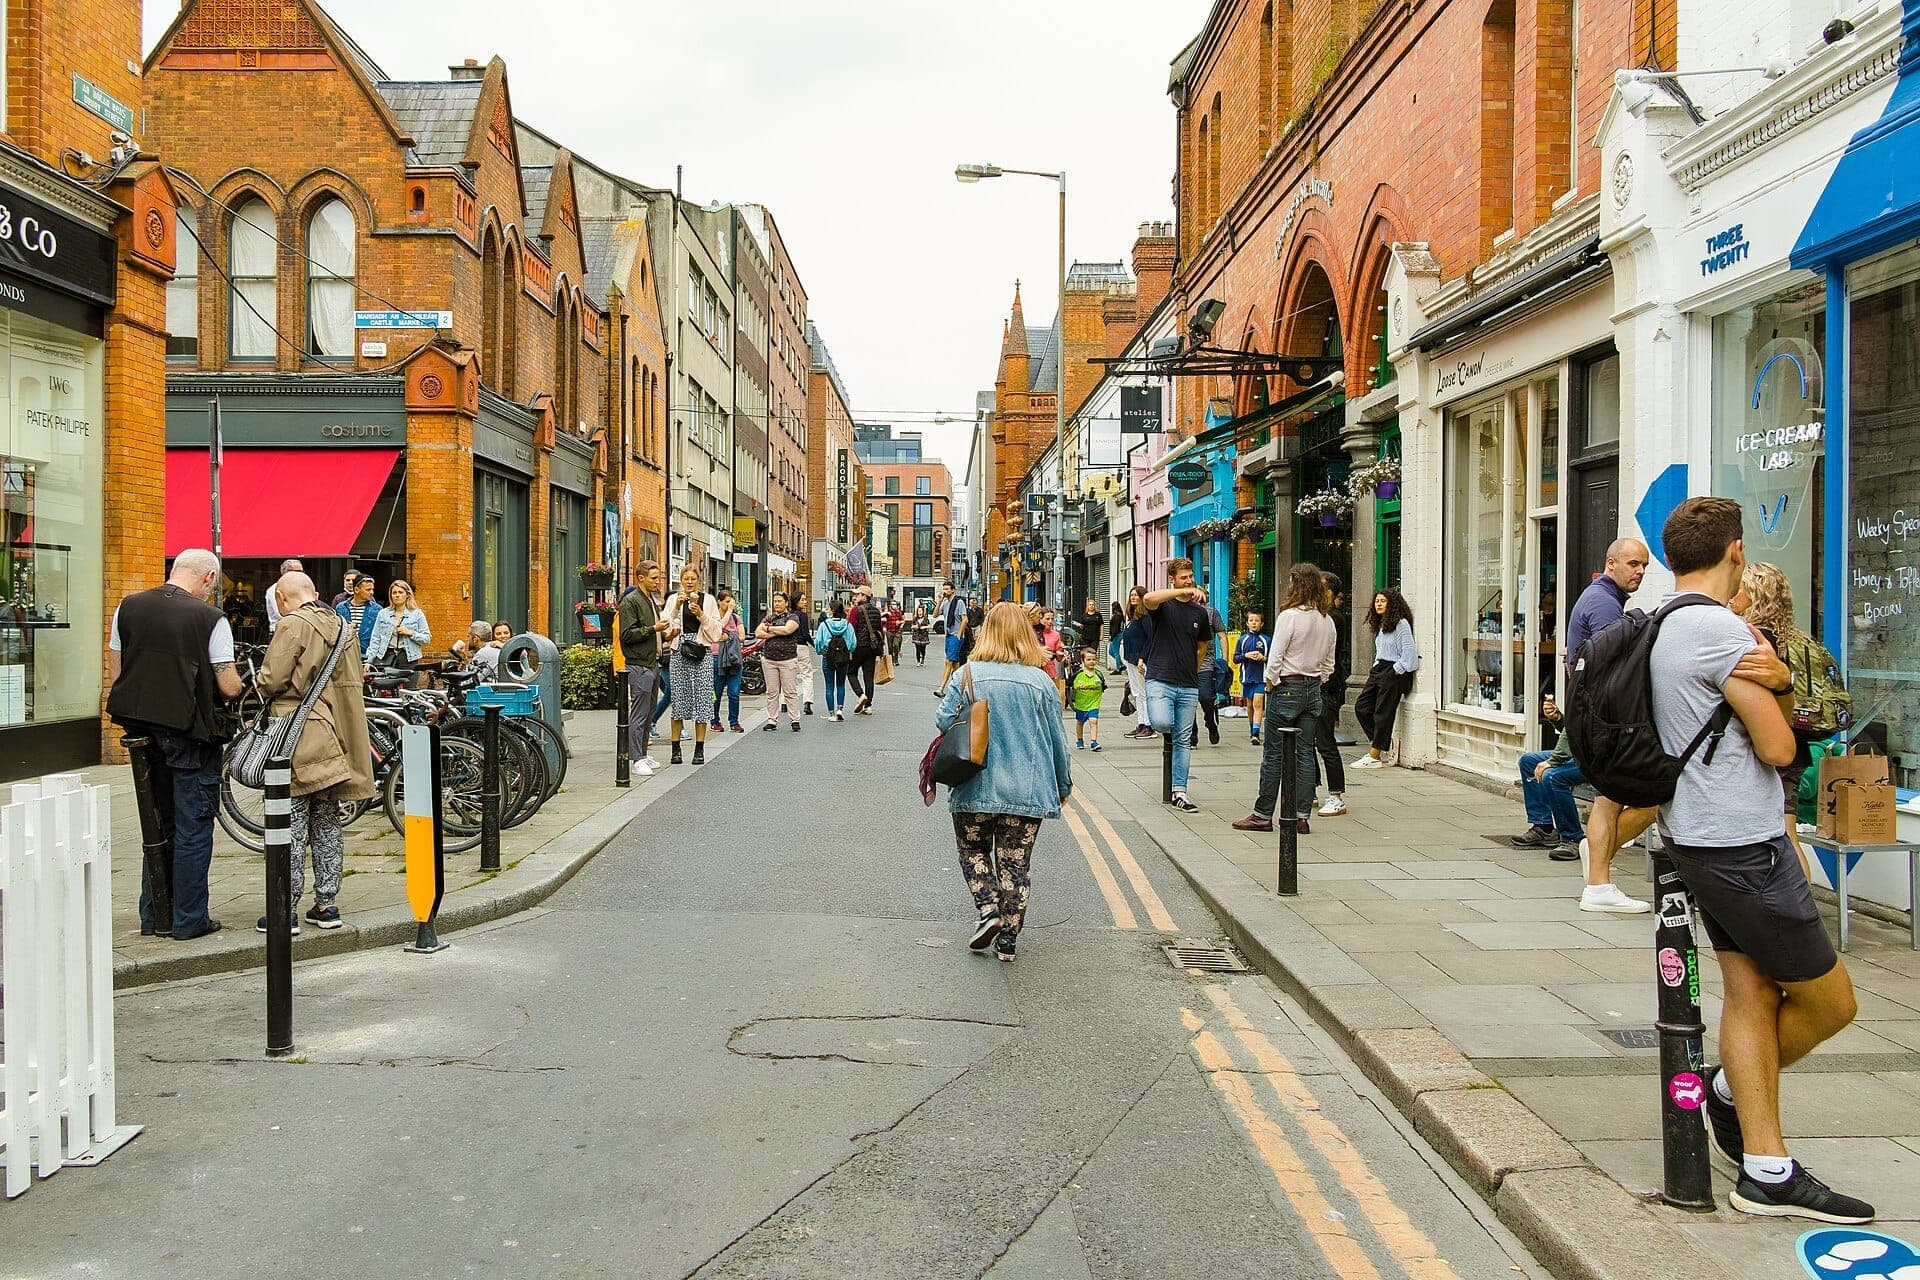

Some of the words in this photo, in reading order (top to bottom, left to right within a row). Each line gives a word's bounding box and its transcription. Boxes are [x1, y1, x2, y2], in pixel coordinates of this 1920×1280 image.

[19, 216, 57, 258] Co
[1706, 224, 1743, 254] THREE
[1700, 241, 1750, 276] TWENTY
[442, 316, 449, 324] 2
[49, 376, 70, 395] IWC
[27, 409, 53, 429] PATEK
[55, 416, 90, 437] PHILIPPE
[321, 421, 392, 437] costume
[1142, 418, 1160, 431] 27
[1852, 567, 1881, 594] Honey
